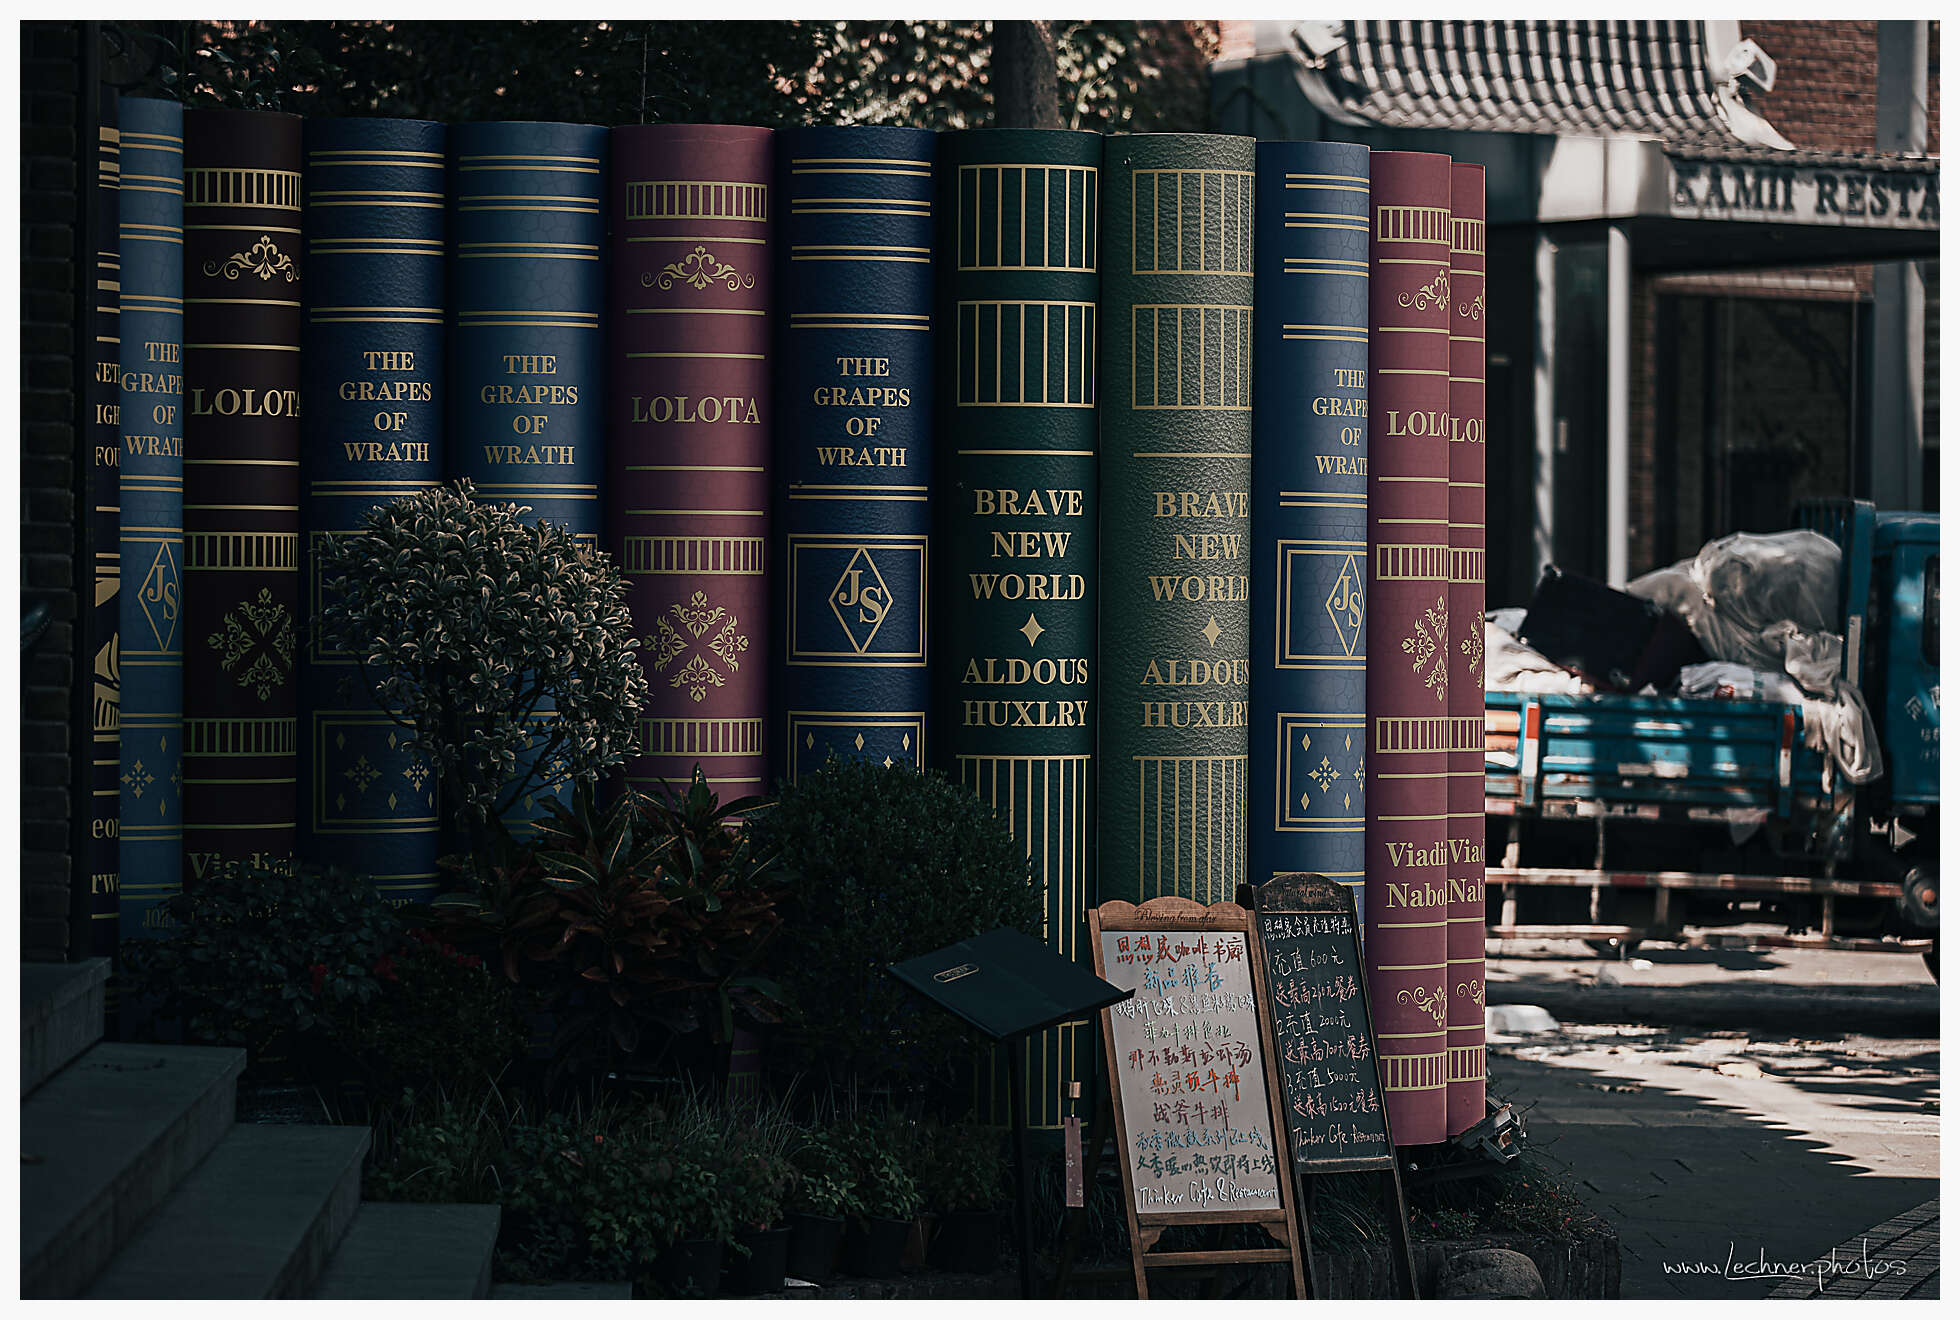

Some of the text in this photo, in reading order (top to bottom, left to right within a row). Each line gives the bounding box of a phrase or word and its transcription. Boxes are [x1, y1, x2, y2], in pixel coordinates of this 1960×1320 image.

[145, 342, 179, 362] THE
[364, 352, 414, 370] THE
[504, 356, 556, 374] THE
[837, 358, 889, 376] THE
[1335, 369, 1365, 388] THE
[341, 382, 431, 400] GRAPES
[482, 386, 577, 404] GRAPES
[814, 388, 910, 406] GRAPES
[153, 406, 176, 424] OF
[632, 395, 761, 424] LOLOTA
[374, 412, 407, 430] OF
[513, 416, 547, 434] OF
[846, 418, 880, 436] OF
[1341, 428, 1361, 445] OF
[344, 443, 428, 461] WRATH
[485, 446, 574, 464] WRATH
[818, 448, 906, 466] WRATH
[976, 490, 1082, 515] BRAVE
[1154, 491, 1248, 518] BRAVE
[992, 532, 1071, 557] NEW
[1173, 534, 1241, 560] NEW
[970, 574, 1084, 600] WORLD
[1149, 575, 1249, 602] WORLD
[964, 659, 1087, 684] ALDOUS
[962, 701, 1088, 727] HUXLRY
